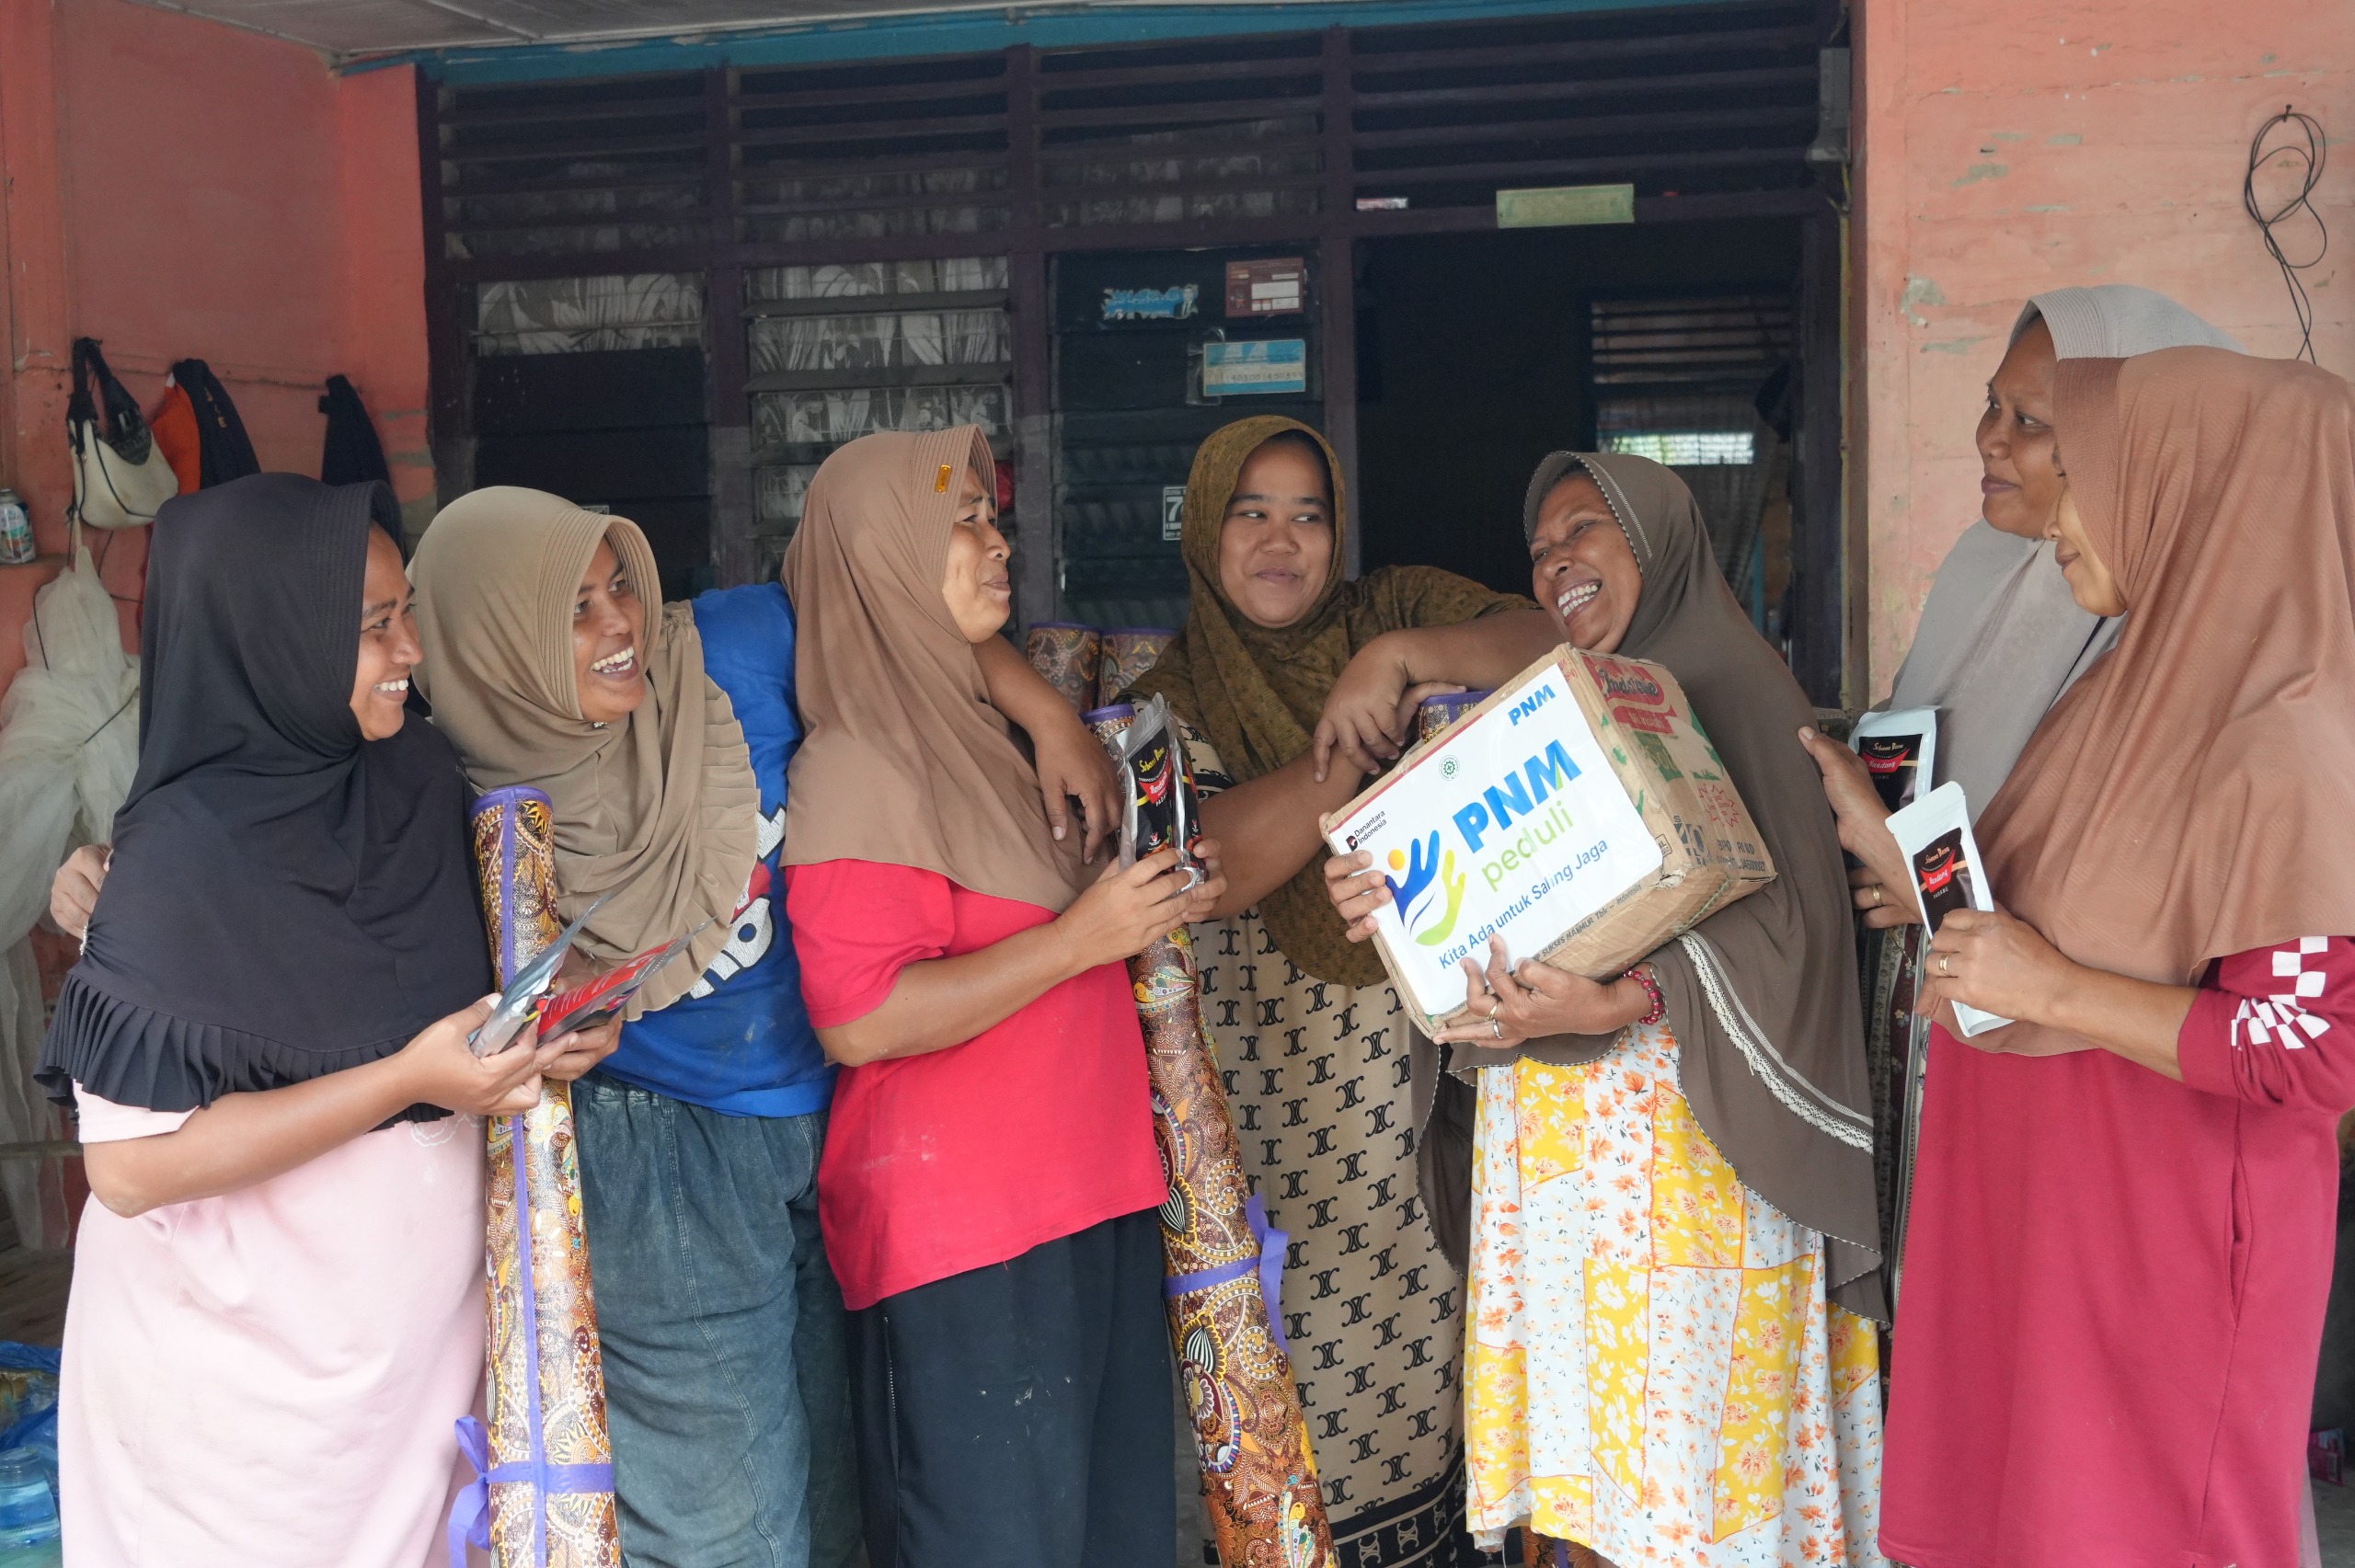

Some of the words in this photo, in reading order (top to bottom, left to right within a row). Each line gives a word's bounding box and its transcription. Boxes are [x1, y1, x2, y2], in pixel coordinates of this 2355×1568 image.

[1508, 684, 1556, 727] PNM
[1452, 738, 1582, 854] PNM
[1354, 810, 1385, 838] Danantara
[1358, 818, 1387, 844] Indonesia
[1481, 800, 1574, 893] peduli
[1439, 945, 1468, 968] Kita
[1468, 923, 1496, 949] Ada
[1495, 894, 1533, 928] untuk
[1532, 864, 1574, 900] Saling
[1575, 840, 1608, 870] Jaga
[1543, 936, 1566, 957] SUKSES
[1566, 918, 1594, 942] MAKMUR
[1595, 907, 1608, 921] Tbk
